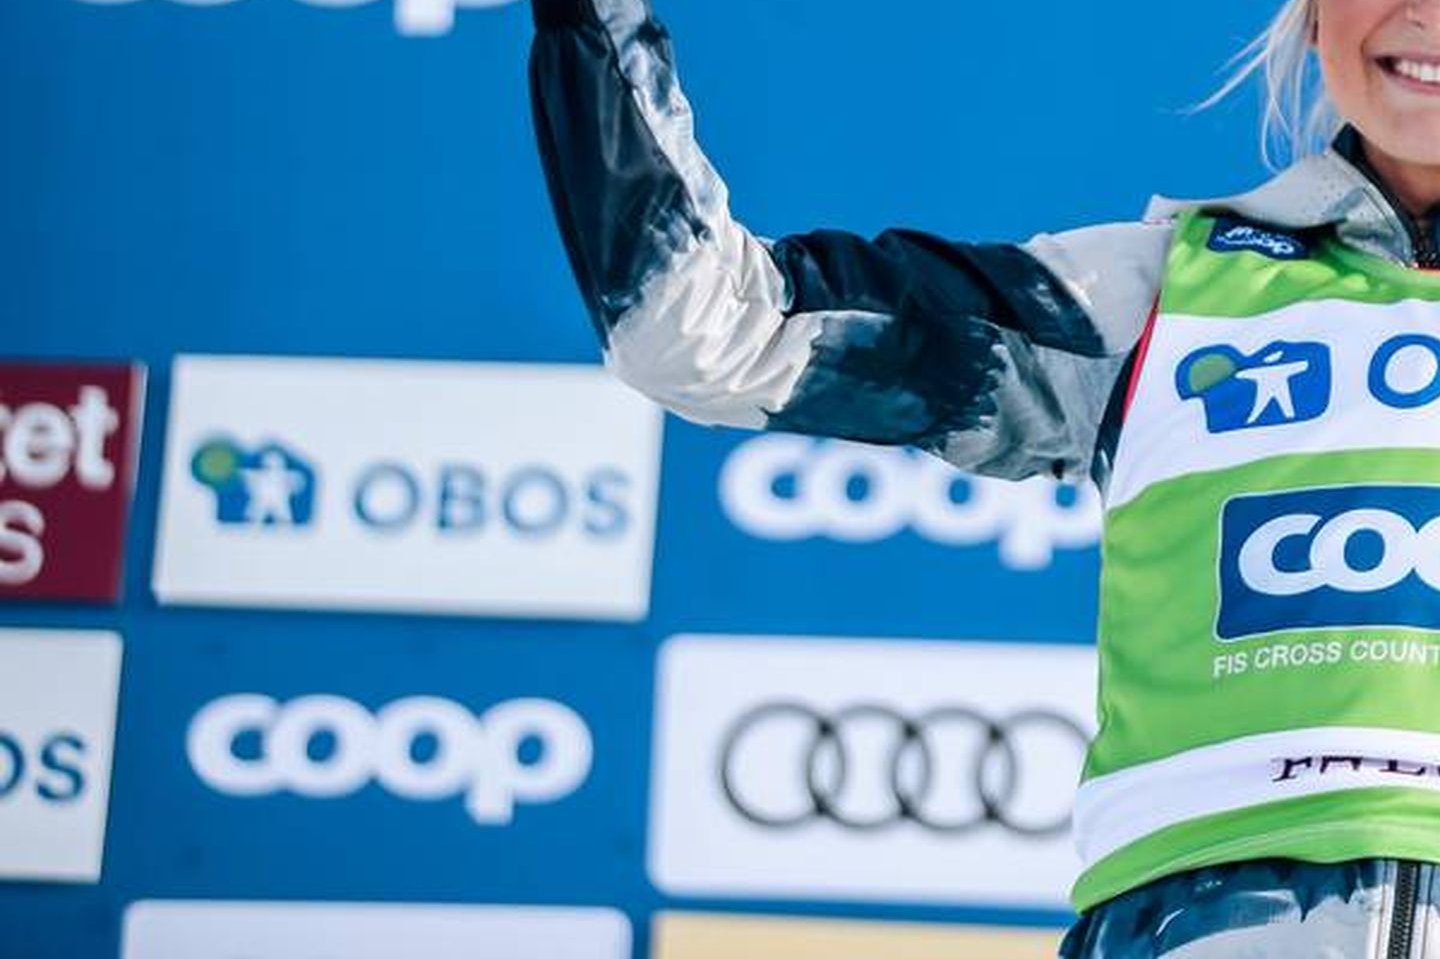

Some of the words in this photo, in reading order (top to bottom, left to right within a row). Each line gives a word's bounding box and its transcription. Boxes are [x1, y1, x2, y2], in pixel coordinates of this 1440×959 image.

[352, 463, 634, 540] OBOS
[717, 431, 1103, 570] coop
[1213, 652, 1248, 679] FIS
[1254, 641, 1342, 669] CROSS
[186, 692, 594, 827] coop
